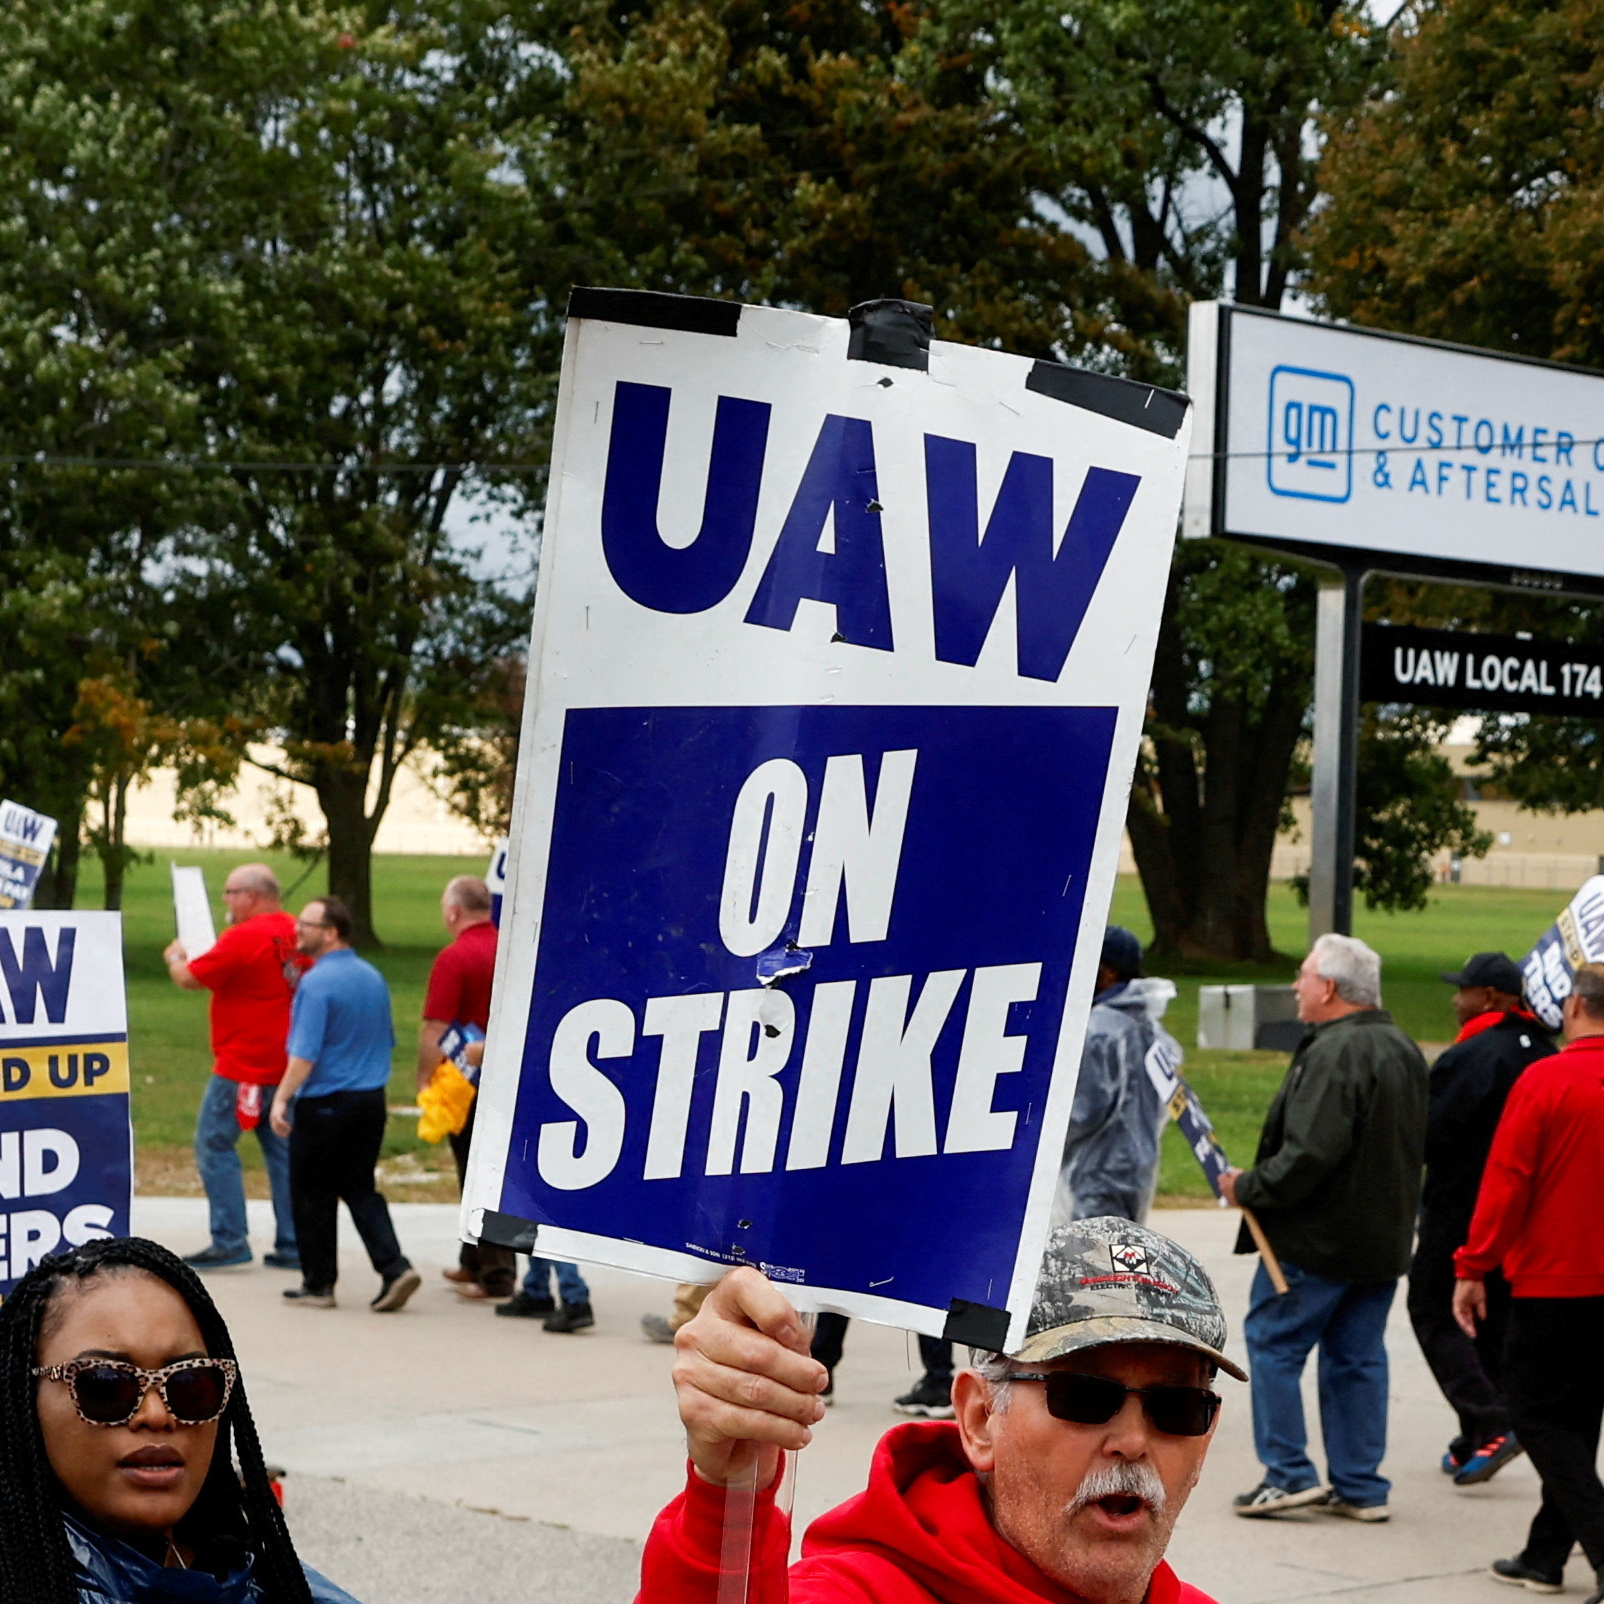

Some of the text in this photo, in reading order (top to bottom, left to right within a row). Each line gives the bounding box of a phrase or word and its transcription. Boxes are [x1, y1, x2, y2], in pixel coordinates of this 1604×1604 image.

[1284, 401, 1338, 464] gm
[1373, 403, 1575, 467] CUSTOMER
[1373, 452, 1393, 490] &
[601, 381, 1142, 683] UAW
[1395, 647, 1603, 699] UAW LOCAL 174
[719, 748, 918, 958] ON
[49, 1053, 110, 1089] UP
[537, 961, 1043, 1191] STRIKE
[1090, 1282, 1133, 1291] ELECTRIC
